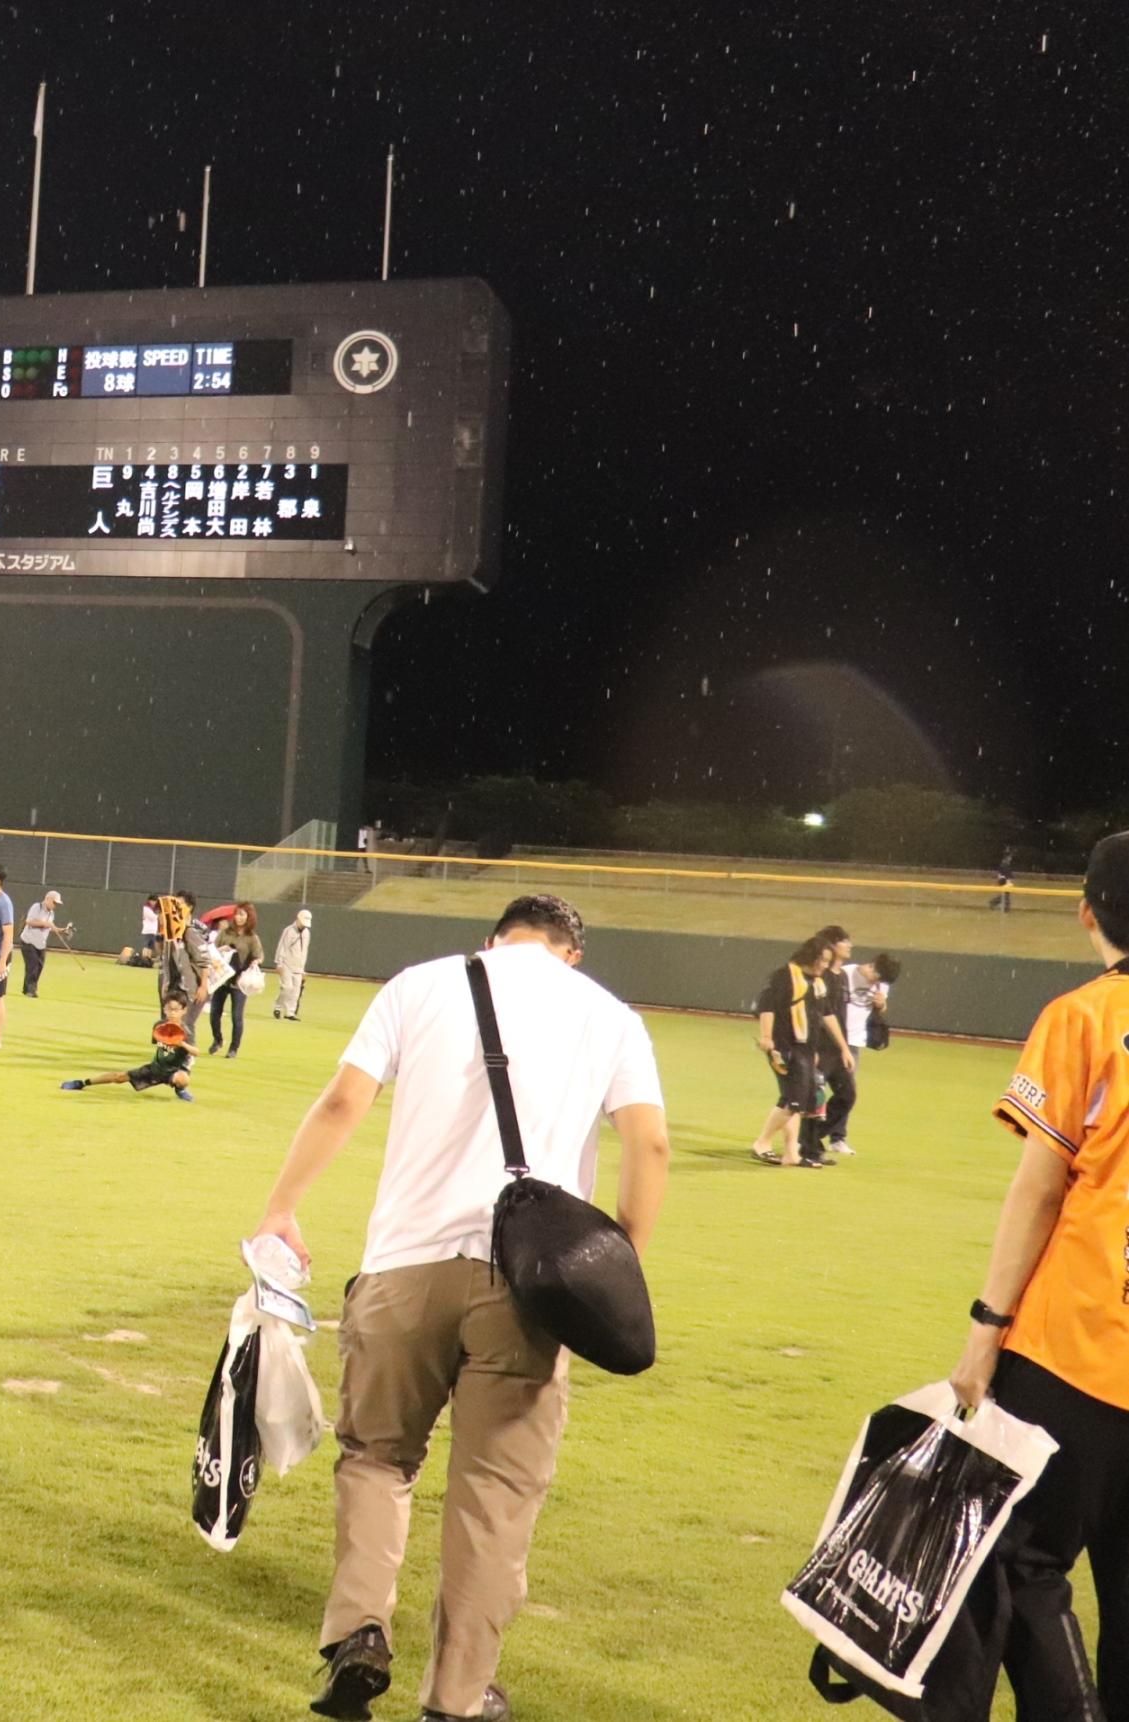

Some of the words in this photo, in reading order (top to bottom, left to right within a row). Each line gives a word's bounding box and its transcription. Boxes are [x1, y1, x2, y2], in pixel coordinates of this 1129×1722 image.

[3, 350, 12, 364] B
[58, 349, 67, 362] H
[85, 351, 137, 368] 投球数
[143, 351, 188, 367] SPEED
[196, 348, 232, 365] TIME
[57, 365, 66, 379] E
[194, 372, 231, 389] 2:54
[97, 447, 113, 460] TN
[126, 447, 132, 460] 1
[147, 447, 156, 460] 2
[170, 446, 178, 460] 3
[193, 446, 201, 460] 4
[216, 446, 225, 460] 5
[239, 446, 248, 460] 6
[264, 445, 271, 460] 7
[286, 446, 295, 459] 8
[310, 445, 319, 459] 9
[122, 464, 133, 479] 9
[144, 464, 156, 479] 4
[167, 464, 178, 479] 8
[190, 464, 201, 479] 5
[214, 464, 225, 479] 6
[237, 464, 249, 479] 2
[262, 464, 272, 479] 7
[284, 464, 295, 479] 3
[310, 464, 317, 479] 1
[115, 499, 134, 517] 丸
[182, 482, 204, 536] 岡本
[301, 499, 320, 518] 泉
[847, 1549, 924, 1623] GIANTS
